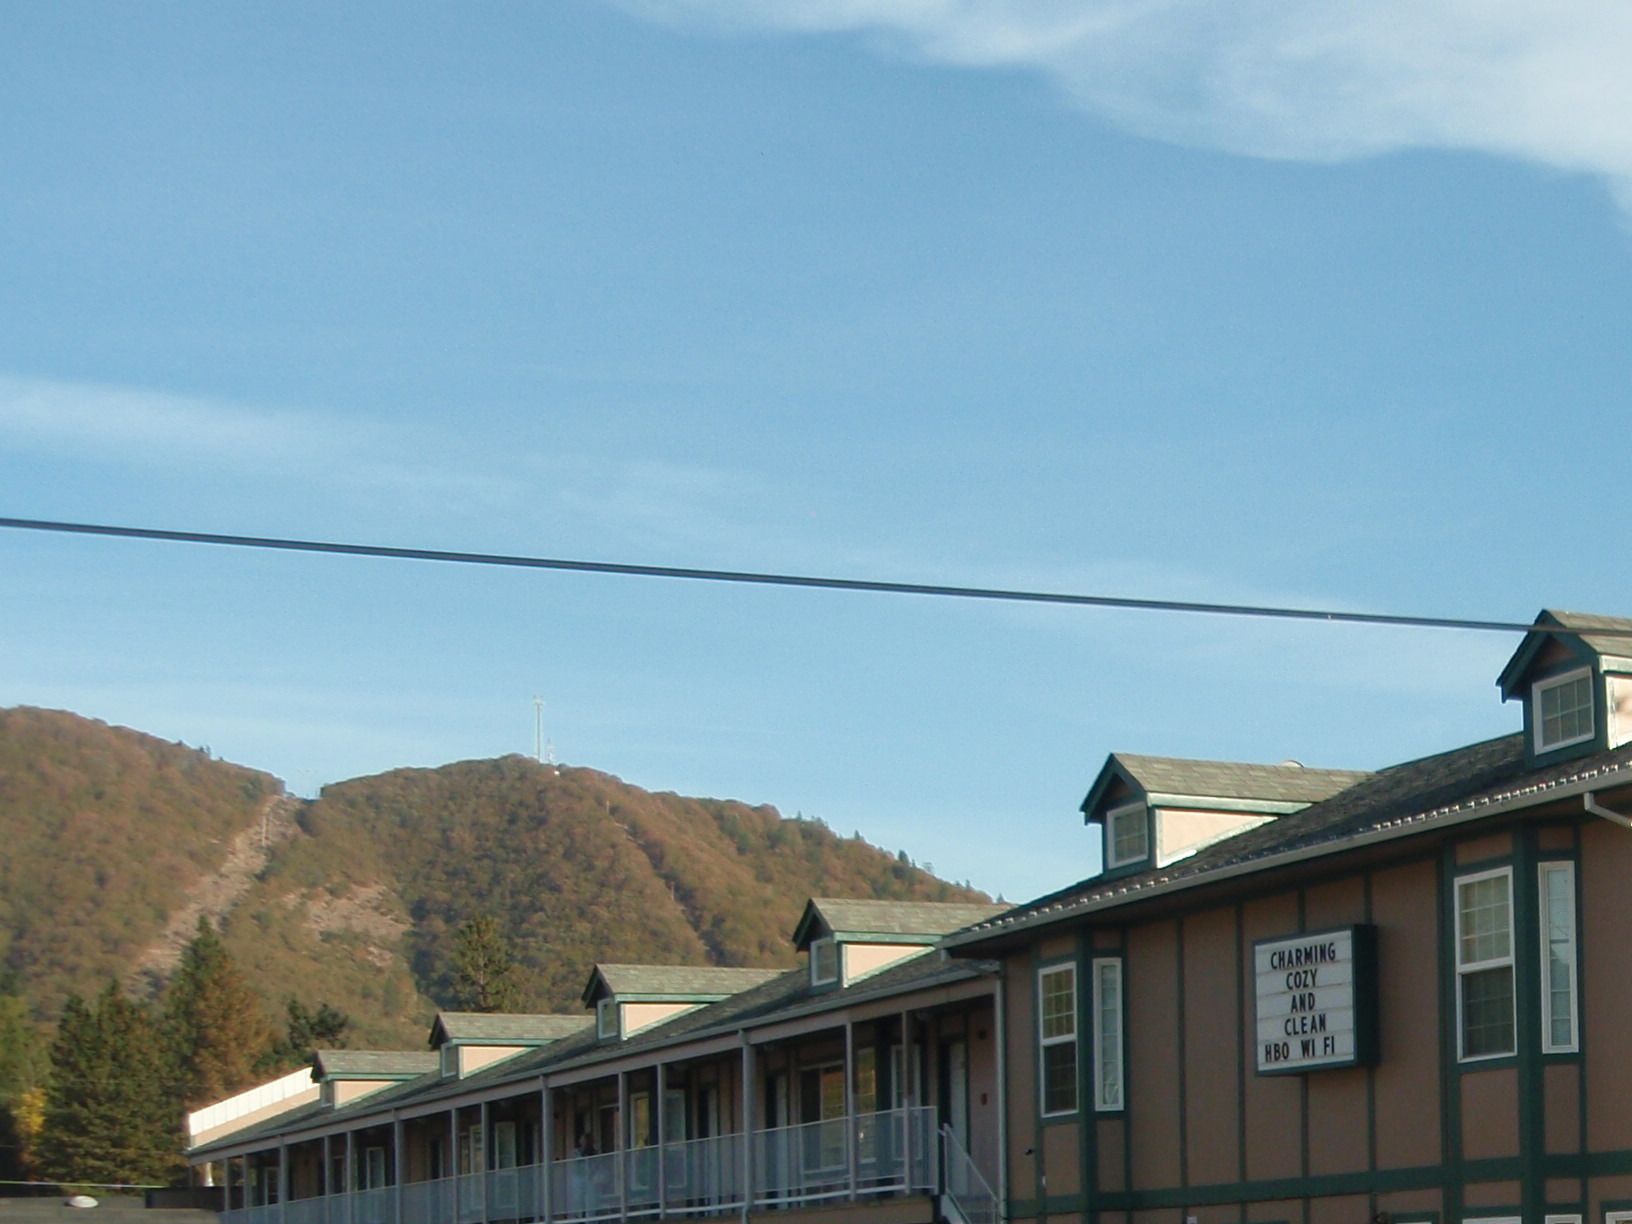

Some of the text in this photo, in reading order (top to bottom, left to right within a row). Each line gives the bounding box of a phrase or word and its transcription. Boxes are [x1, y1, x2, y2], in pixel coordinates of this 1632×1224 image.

[1271, 943, 1335, 969] CHARMING
[1286, 969, 1318, 989] COZY
[1291, 993, 1315, 1013] AND
[1285, 1014, 1326, 1035] CLEAN
[1265, 1036, 1335, 1063] HBO WI FI
